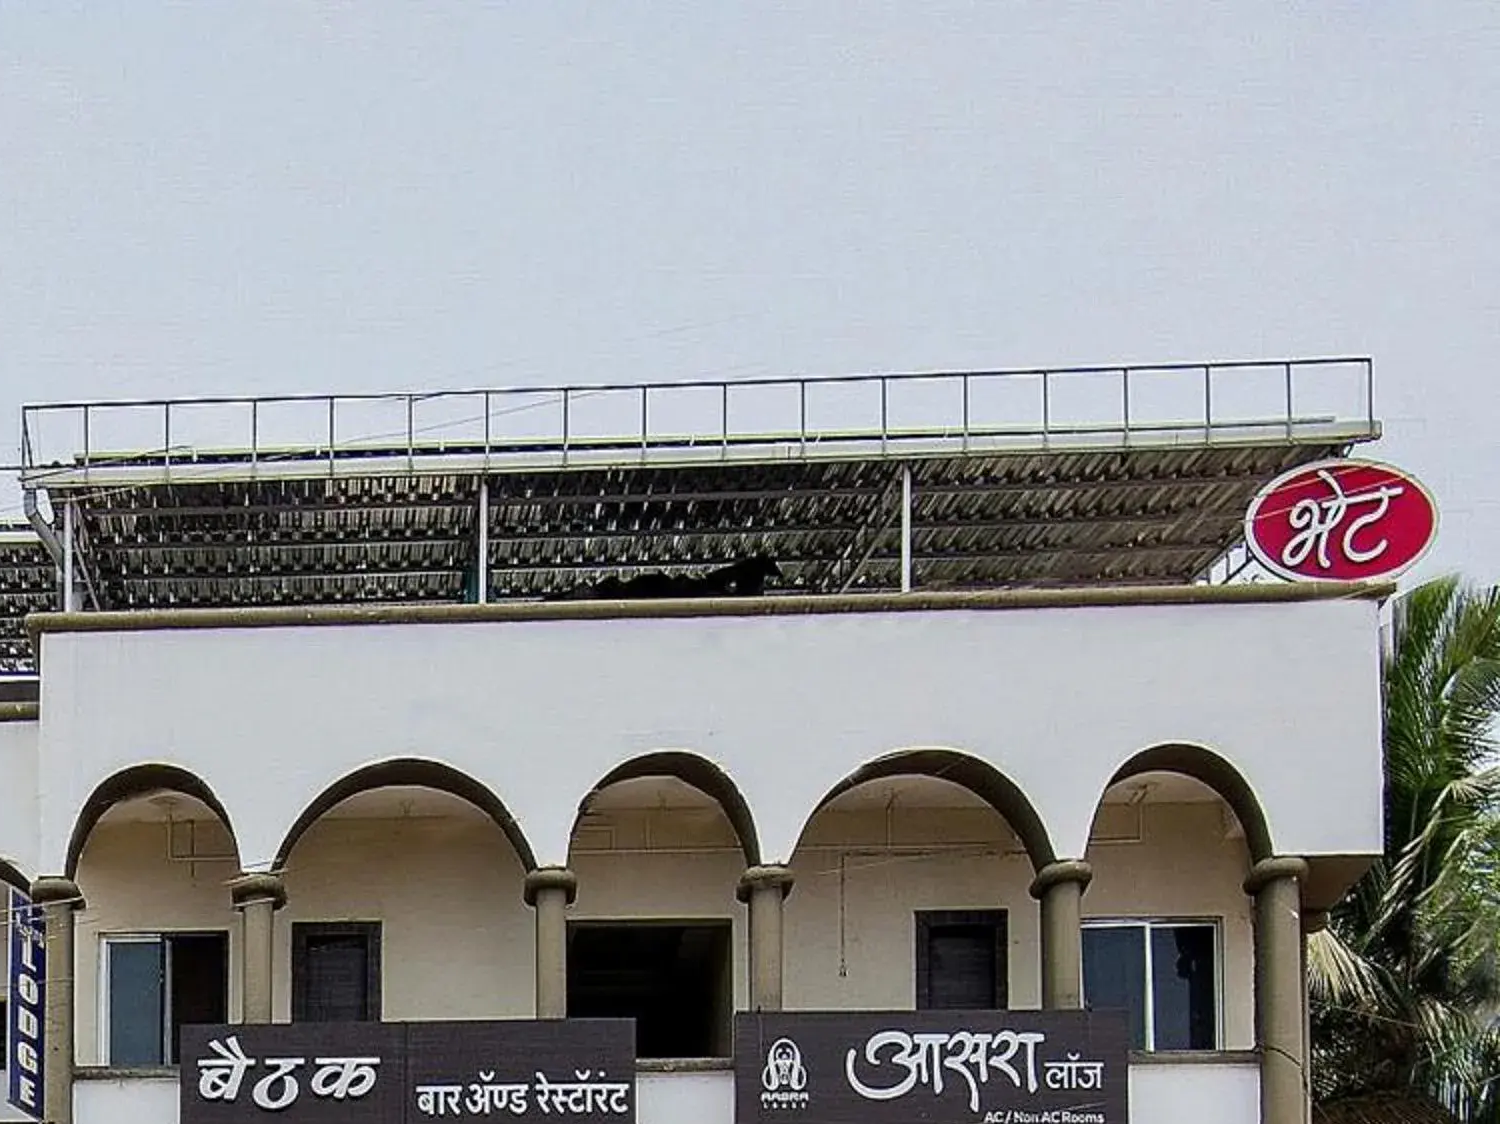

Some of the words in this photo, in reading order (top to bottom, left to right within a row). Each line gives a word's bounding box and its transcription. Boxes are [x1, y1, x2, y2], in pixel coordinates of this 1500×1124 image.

[197, 1036, 381, 1111] बैठक
[416, 1084, 463, 1115] बार
[533, 1069, 630, 1116] रेस्टॉरंट
[846, 1030, 1045, 1112] आसरा
[1045, 1053, 1104, 1090] लॉज
[1041, 1111, 1060, 1123] AC
[1061, 1111, 1105, 1124] Rooms
